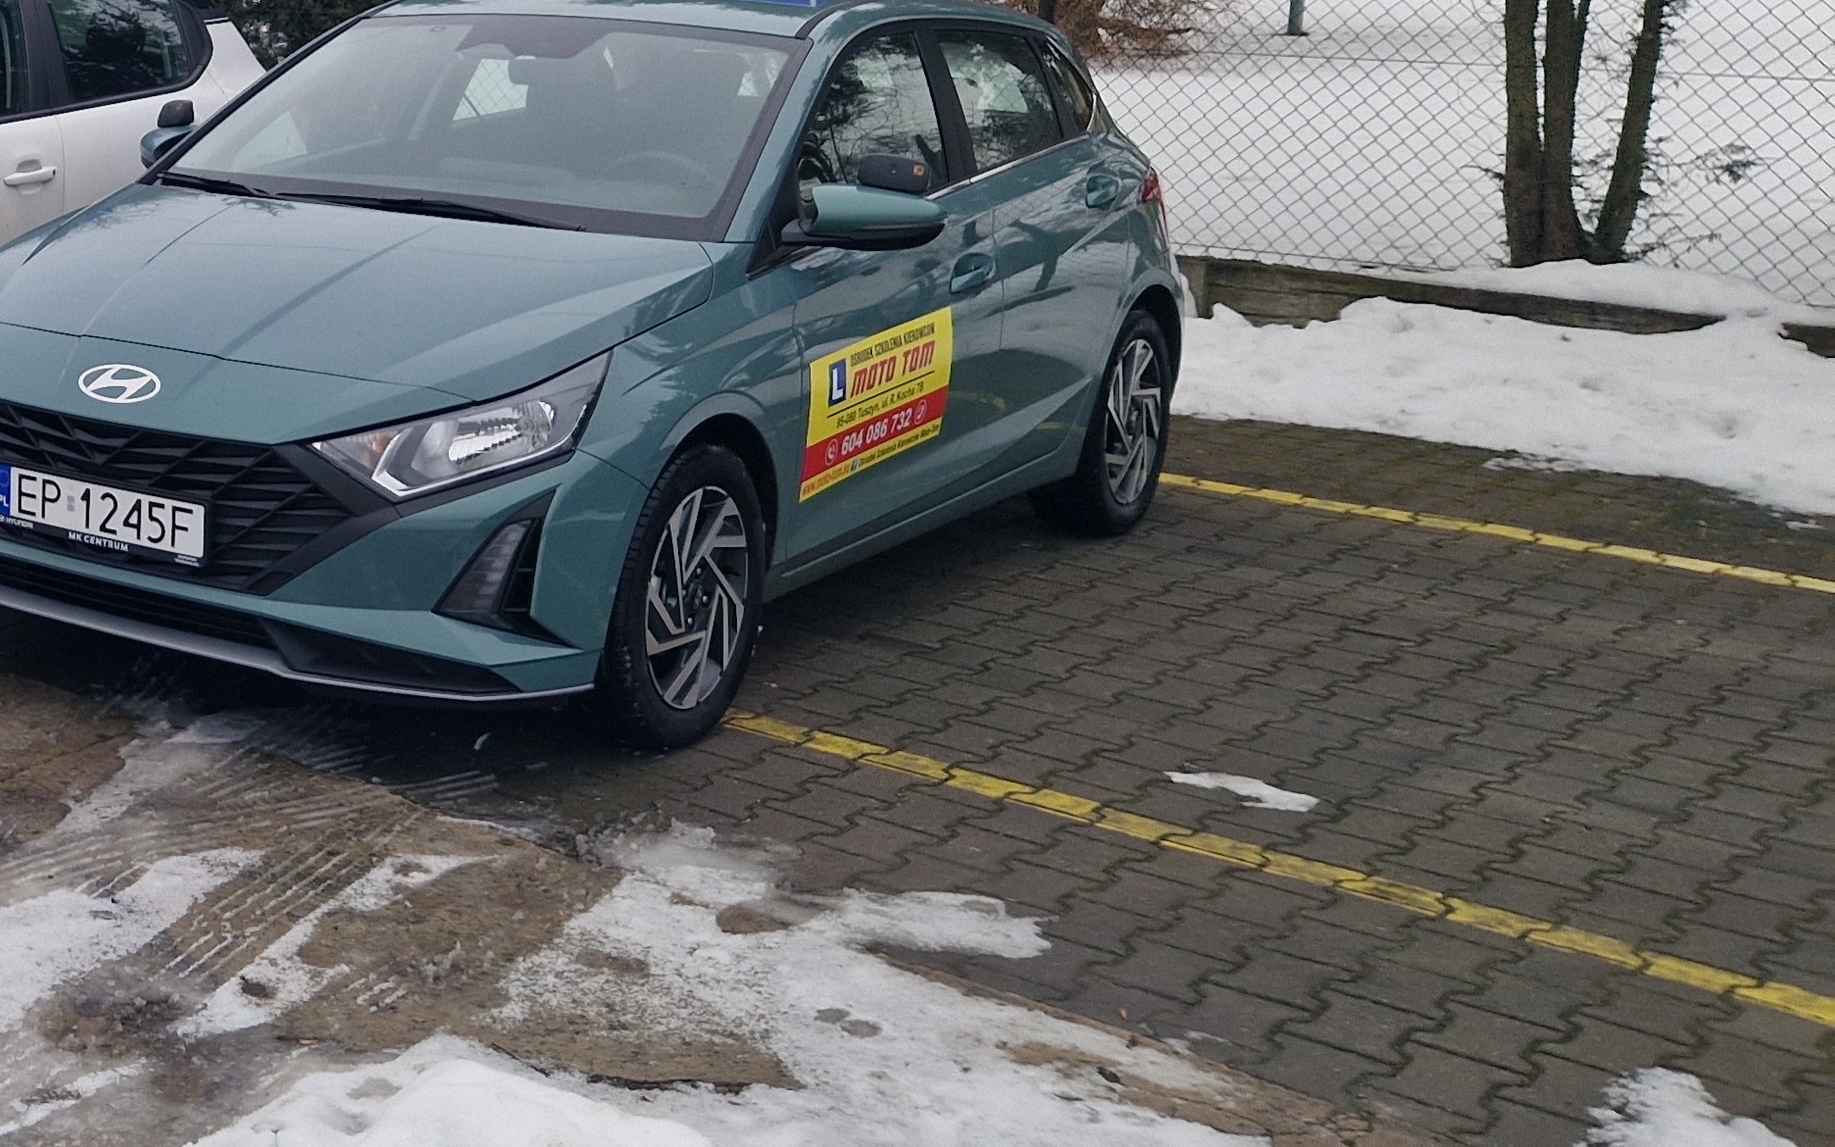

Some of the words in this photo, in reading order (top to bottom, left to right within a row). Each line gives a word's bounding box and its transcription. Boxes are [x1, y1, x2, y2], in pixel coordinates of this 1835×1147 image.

[831, 368, 844, 401] L
[850, 355, 896, 398] MOTO
[902, 340, 936, 376] TOM
[841, 428, 863, 456] 604
[866, 418, 888, 444] 086
[891, 407, 912, 434] 732
[18, 473, 62, 519] EP
[80, 487, 194, 548] 1245F
[68, 531, 82, 542] MK
[83, 535, 129, 552] CENTRUM
